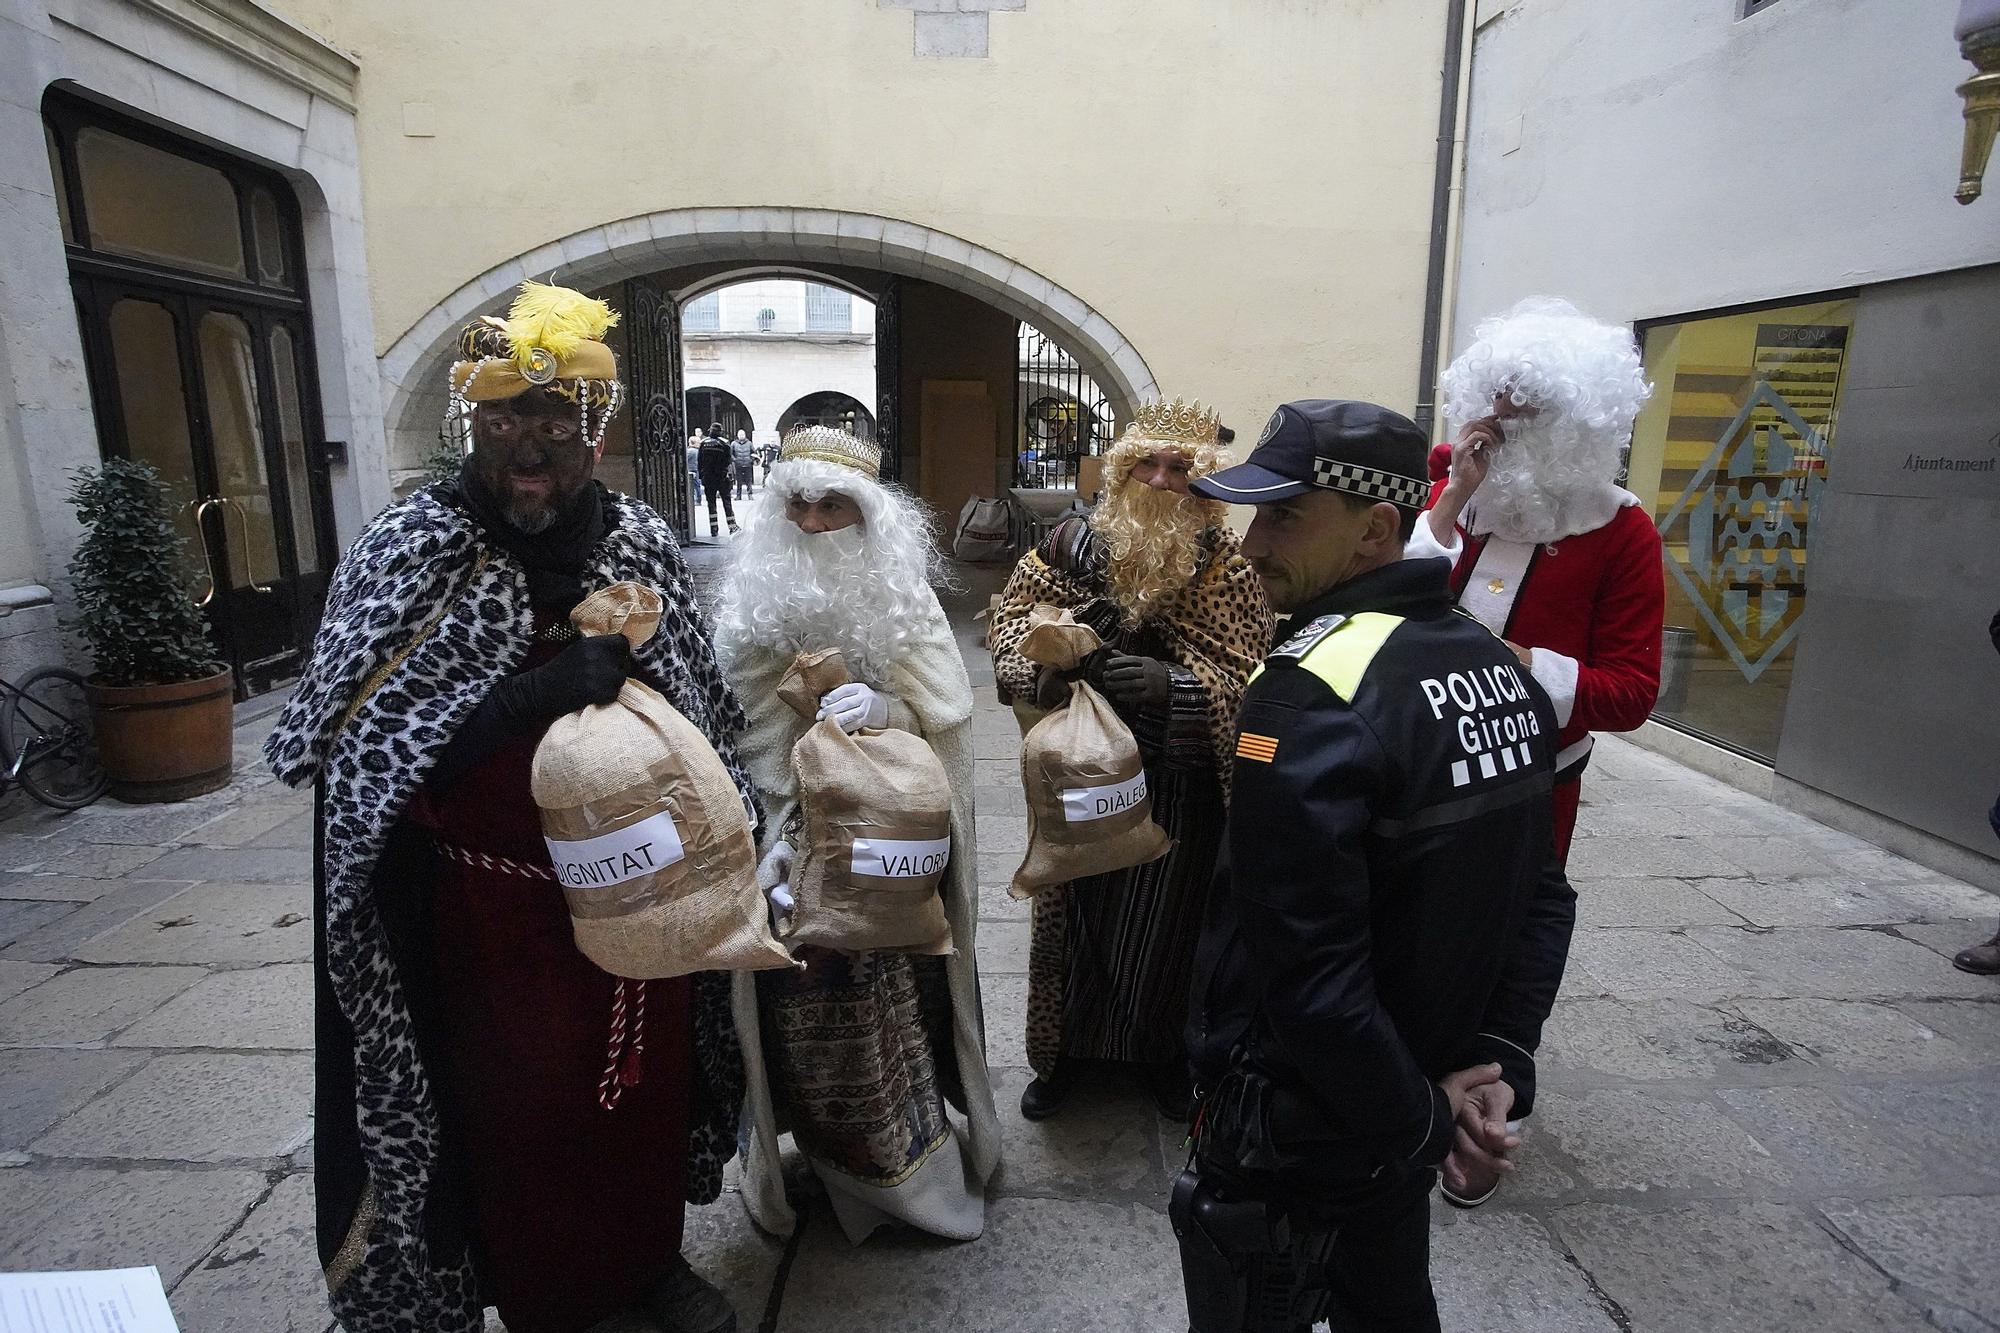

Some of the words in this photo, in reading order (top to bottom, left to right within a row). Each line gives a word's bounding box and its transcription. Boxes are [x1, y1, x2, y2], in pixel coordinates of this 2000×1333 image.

[1778, 327, 1827, 342] GIRONA
[1902, 453, 1997, 473] Ajuntament
[1420, 665, 1531, 720] POLICIA
[1457, 710, 1541, 755] Girona
[1096, 781, 1145, 815] DIÀLEG
[554, 842, 655, 885] DIGNITAT
[881, 851, 946, 876] VALORS
